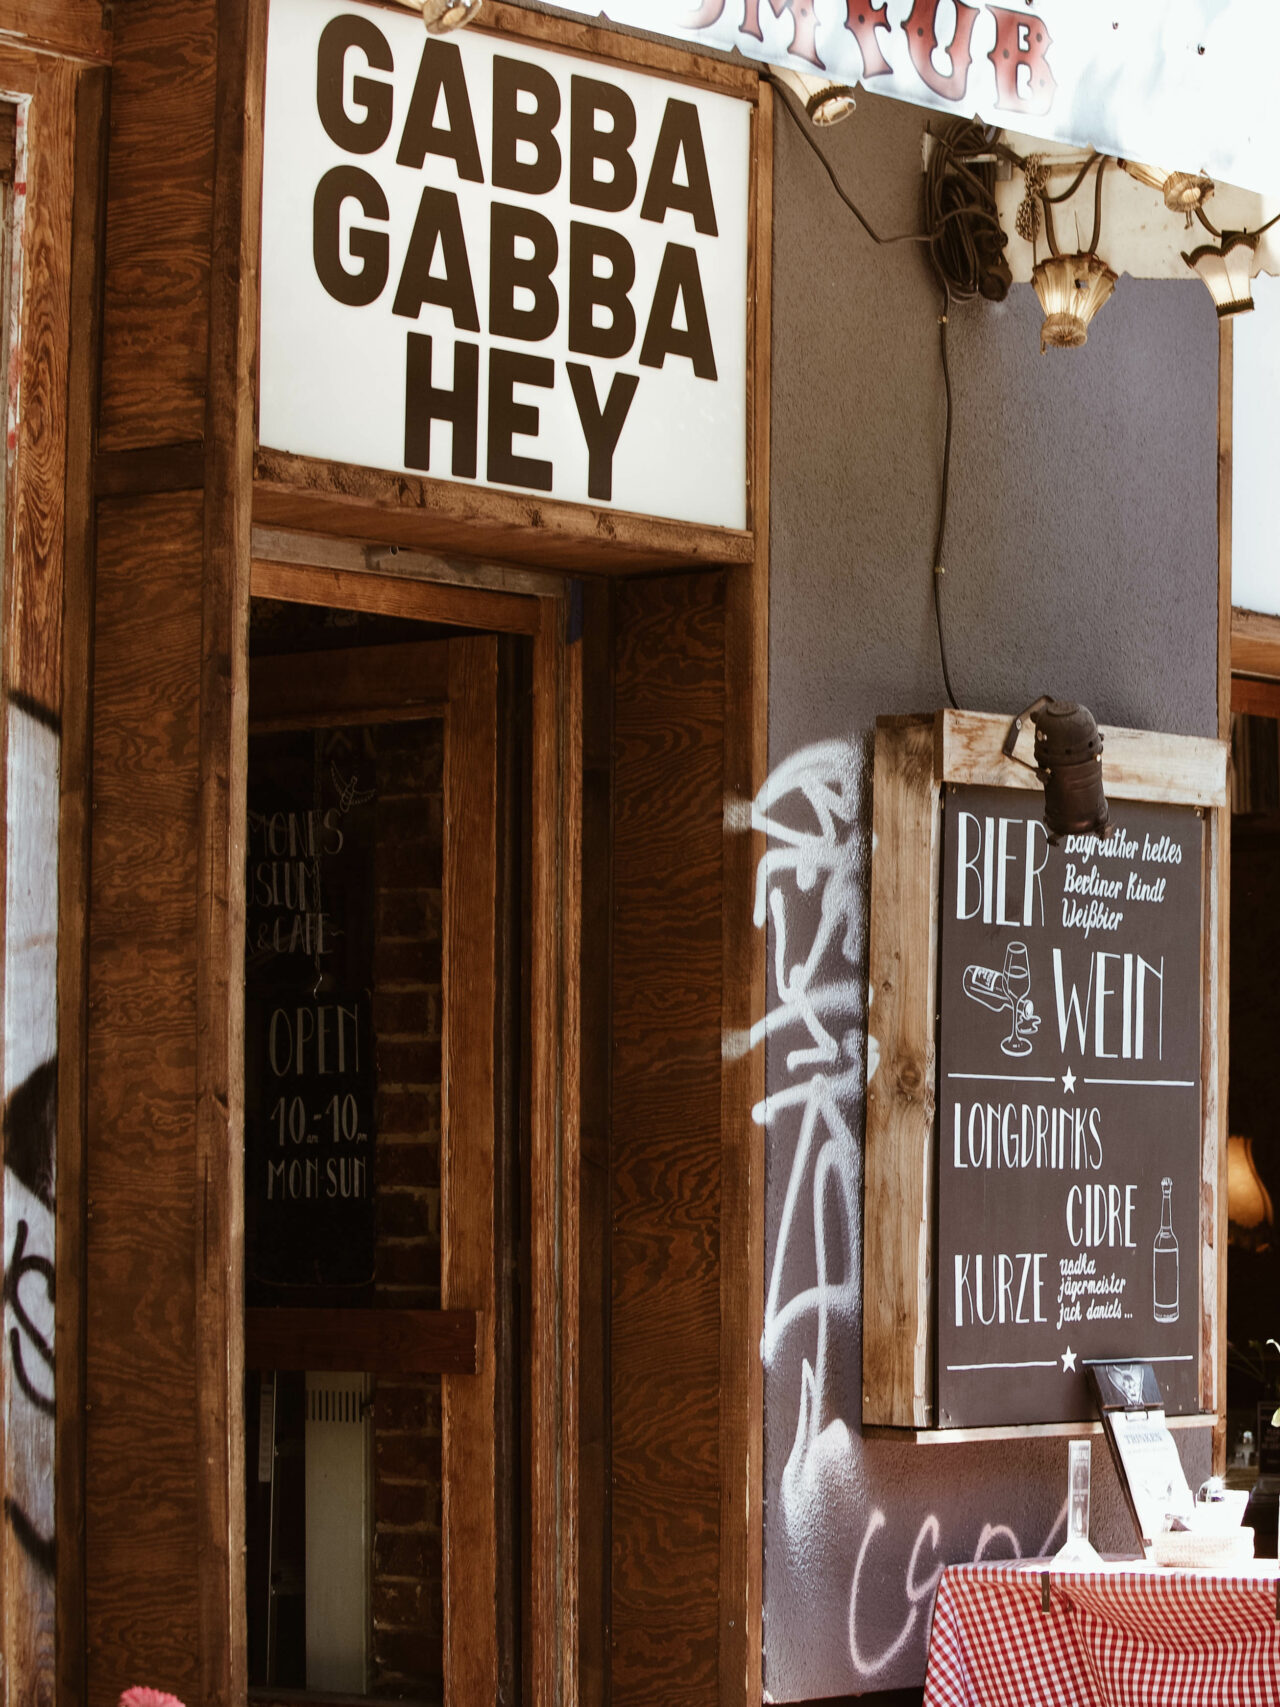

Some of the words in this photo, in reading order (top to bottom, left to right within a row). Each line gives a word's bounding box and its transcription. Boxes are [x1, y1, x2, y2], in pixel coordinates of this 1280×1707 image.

[317, 13, 718, 237] GABBA
[313, 165, 718, 381] GABBA
[404, 333, 639, 501] HEY
[957, 812, 1050, 927] BIER
[1142, 833, 1182, 864] helles
[1064, 864, 1122, 900] Berliner
[1126, 872, 1166, 903] Kindl
[1062, 898, 1123, 939] Weißbier
[269, 1003, 360, 1077] OPEN
[1053, 948, 1164, 1061] WEIN
[954, 1103, 1103, 1170] LONGDRINKS
[1066, 1184, 1137, 1247] CIDRE
[955, 1253, 1047, 1326] KURZE
[1059, 1253, 1097, 1276] vodka
[1056, 1300, 1082, 1330] jack
[1057, 1272, 1127, 1303] jägermeister
